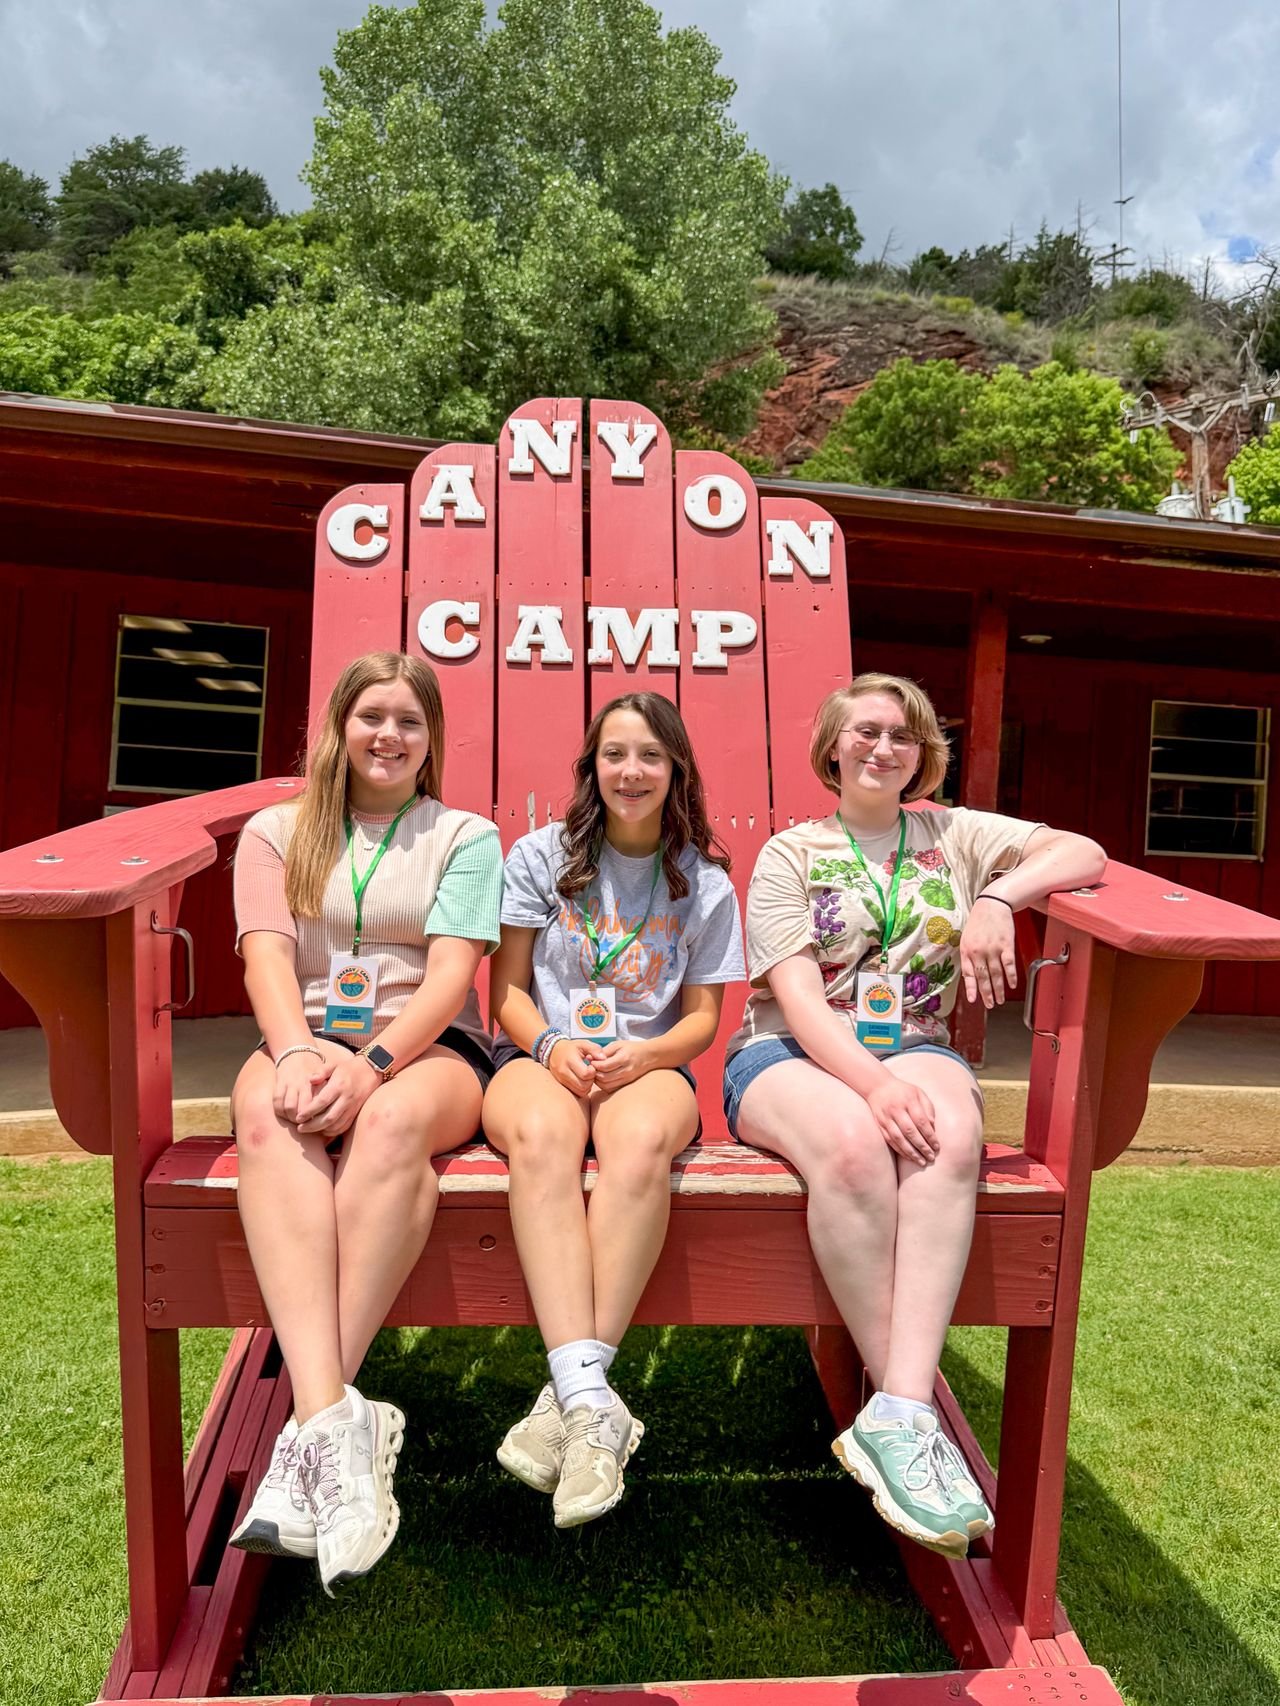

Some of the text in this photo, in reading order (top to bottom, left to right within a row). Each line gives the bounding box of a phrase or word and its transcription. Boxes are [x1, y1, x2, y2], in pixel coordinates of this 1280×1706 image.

[326, 418, 834, 578] CANYON
[417, 600, 758, 669] CAMP
[337, 967, 370, 983] ENERGY CAMP
[865, 984, 896, 999] ENERGY CAMP
[577, 999, 609, 1013] ENERGY CAMP
